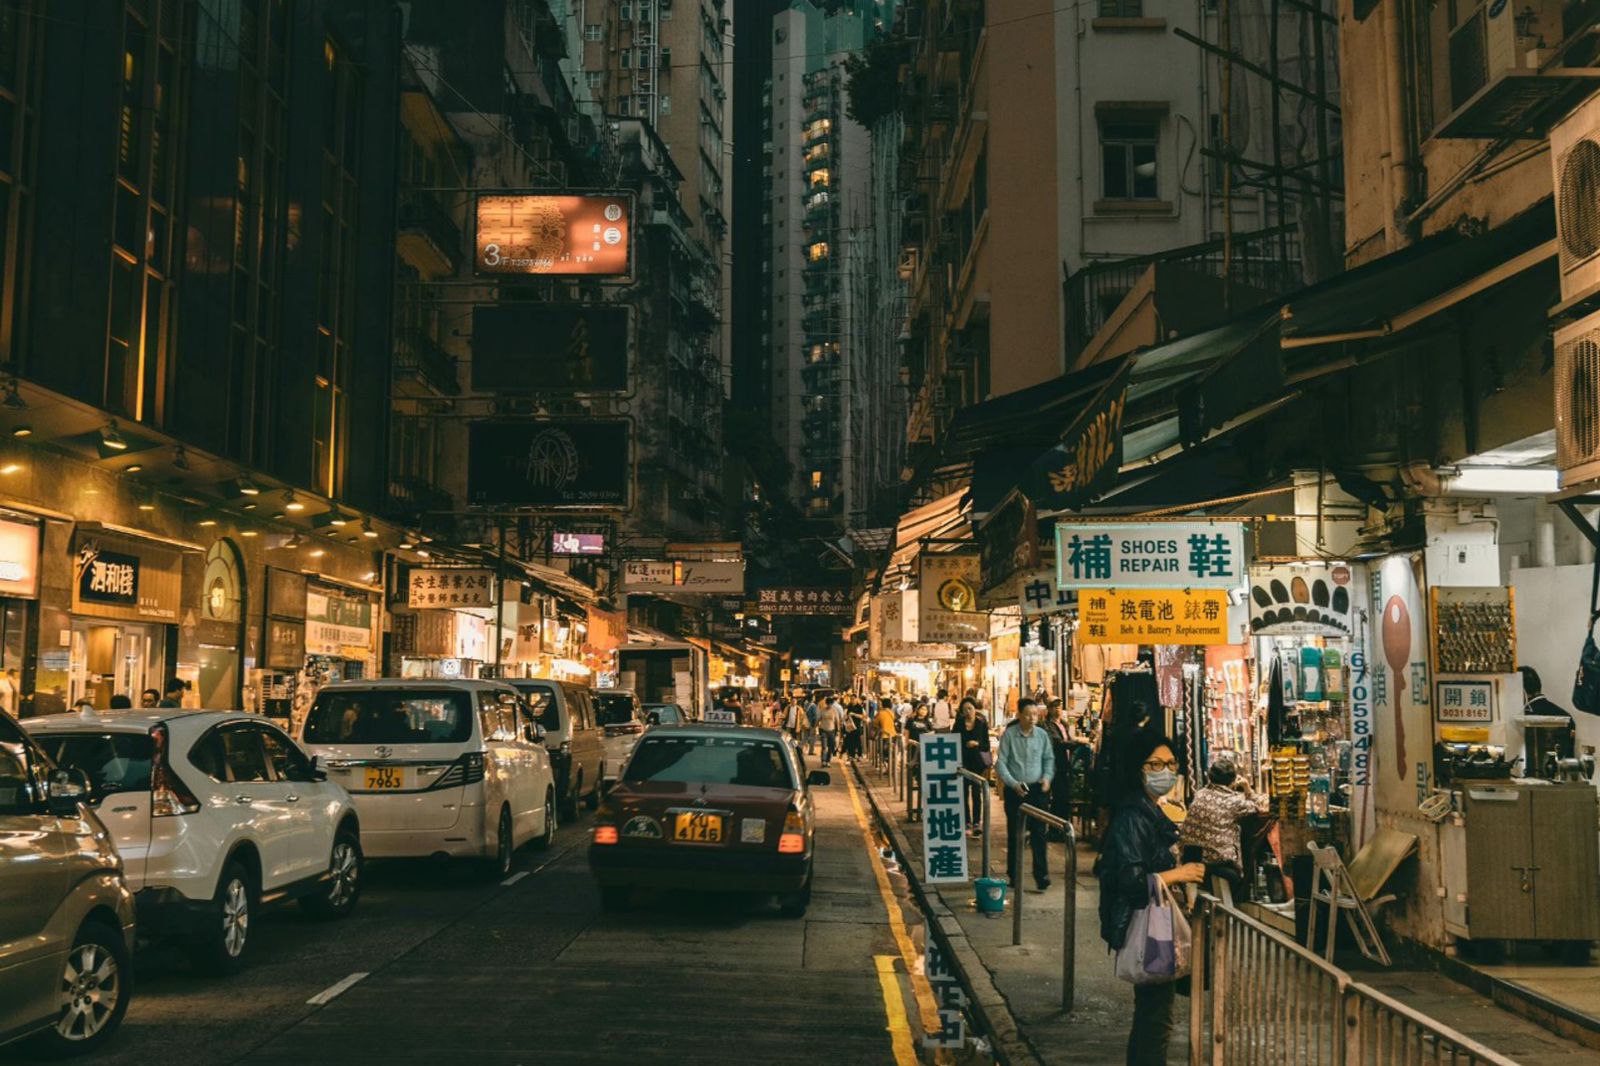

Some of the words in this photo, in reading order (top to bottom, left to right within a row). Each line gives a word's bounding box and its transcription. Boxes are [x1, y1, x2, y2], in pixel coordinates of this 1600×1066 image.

[1121, 540, 1177, 553] SHOES
[1068, 534, 1112, 579] 補
[1187, 534, 1232, 578] 鞋
[1120, 559, 1180, 572] REPAIR
[1088, 597, 1106, 610] 補
[1088, 624, 1107, 637] 鞋
[1120, 625, 1133, 634] Belt
[1138, 625, 1144, 634] &
[1147, 625, 1172, 636] Battery
[1176, 625, 1220, 636] Replacement
[1444, 687, 1488, 707] 開鎖
[707, 712, 733, 721] TAXI
[1351, 652, 1371, 786] 67058482
[1443, 709, 1464, 717] 9031
[1466, 709, 1488, 717] 8167
[925, 737, 964, 878] 中正地產
[679, 828, 717, 840] 4146
